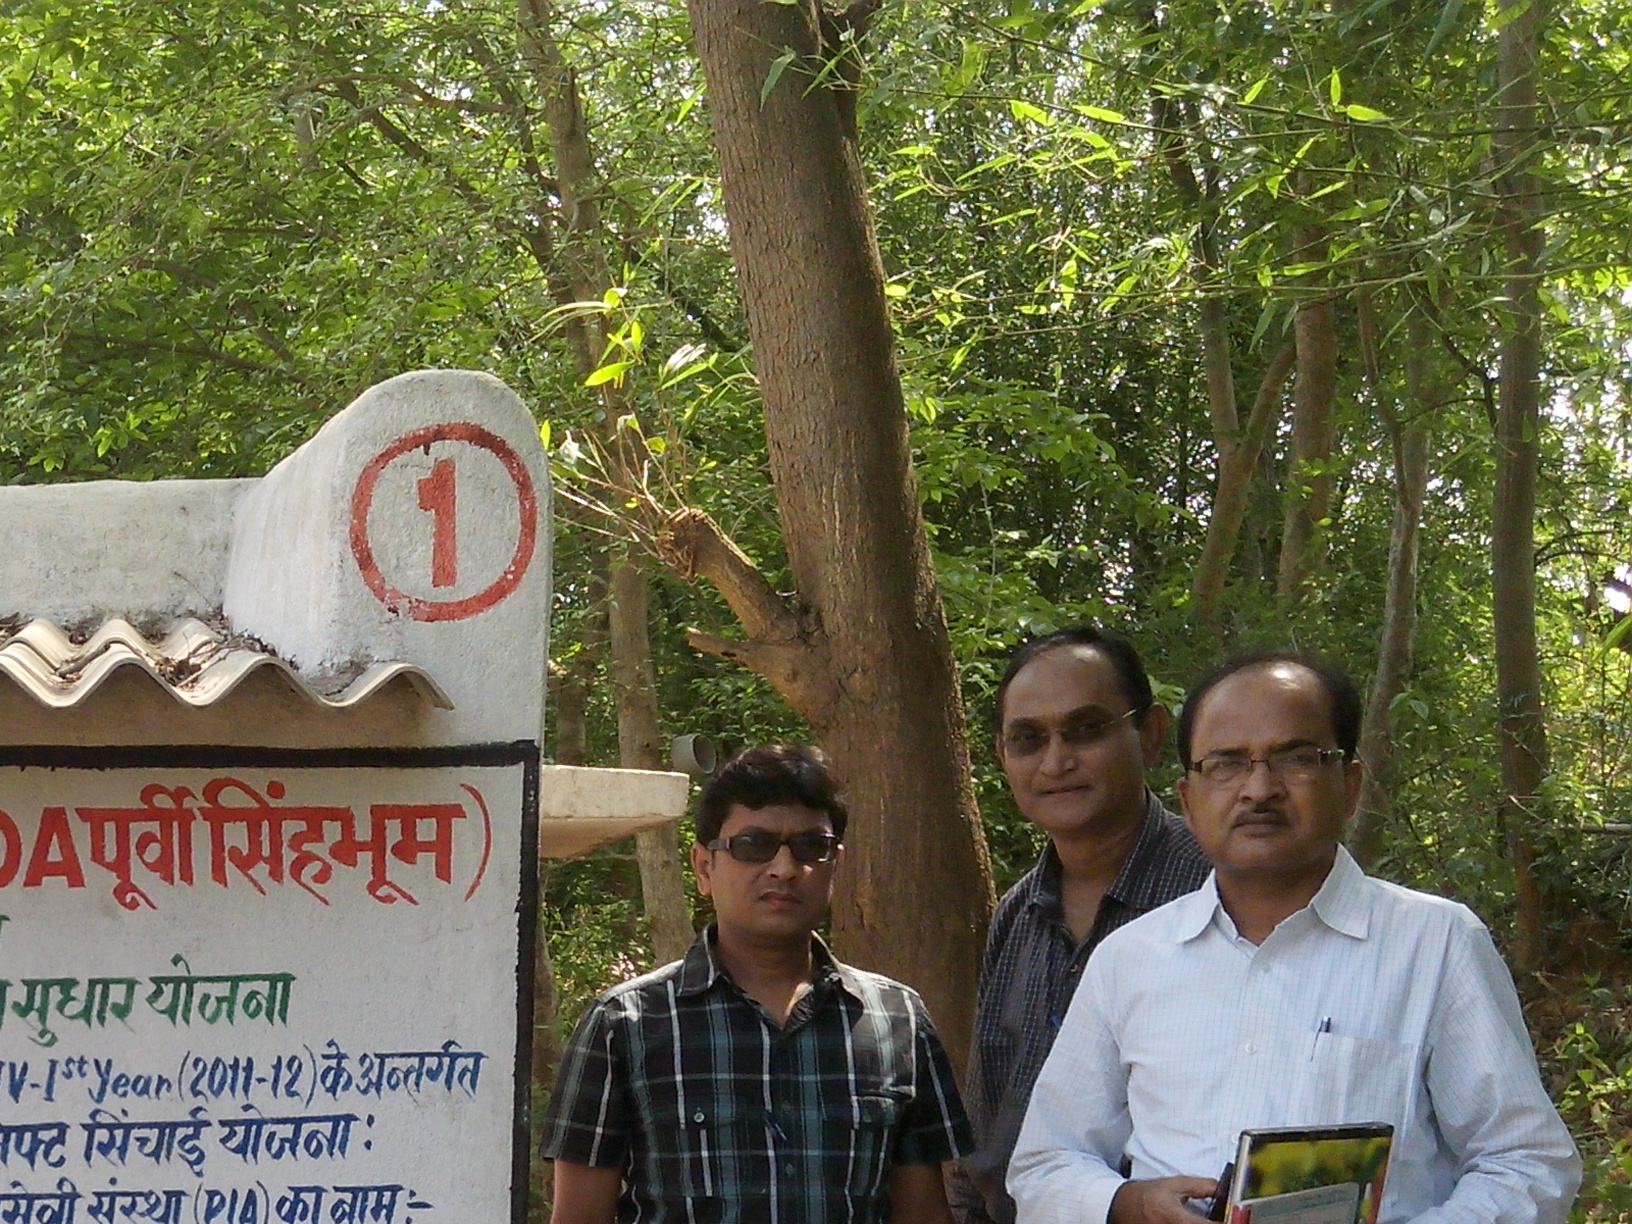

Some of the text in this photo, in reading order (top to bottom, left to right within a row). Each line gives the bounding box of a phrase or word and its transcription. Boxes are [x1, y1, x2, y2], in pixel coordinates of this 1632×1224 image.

[418, 456, 458, 588] 1
[75, 782, 198, 910] पूर्वी
[9, 975, 144, 1048] सुधार
[144, 952, 297, 1029] योजना
[87, 1058, 174, 1104] Year
[319, 1038, 353, 1100] के
[356, 1038, 489, 1104] अन्तर्गत
[79, 1107, 212, 1178] सिंचाई
